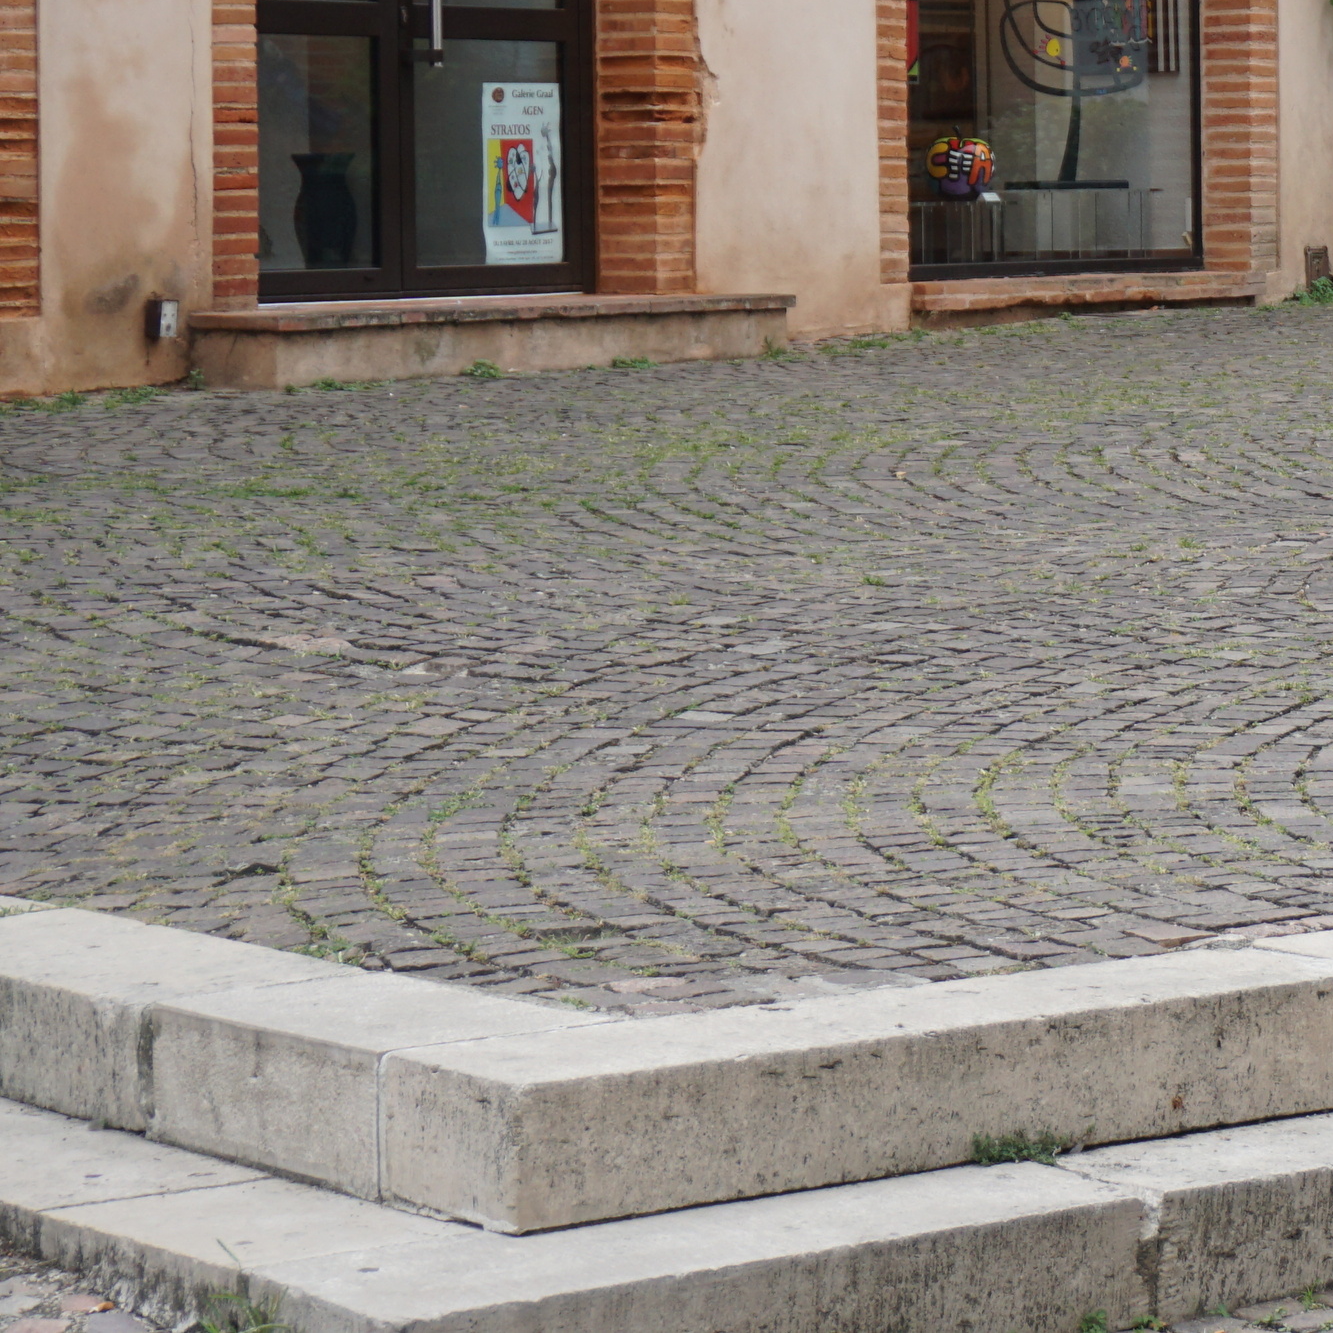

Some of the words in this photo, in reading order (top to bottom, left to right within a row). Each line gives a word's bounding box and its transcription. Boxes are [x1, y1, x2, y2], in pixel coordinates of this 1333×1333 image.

[512, 89, 535, 98] Galerie
[536, 89, 554, 98] Graal
[522, 106, 544, 116] AGEN
[491, 124, 531, 136] STRATOS
